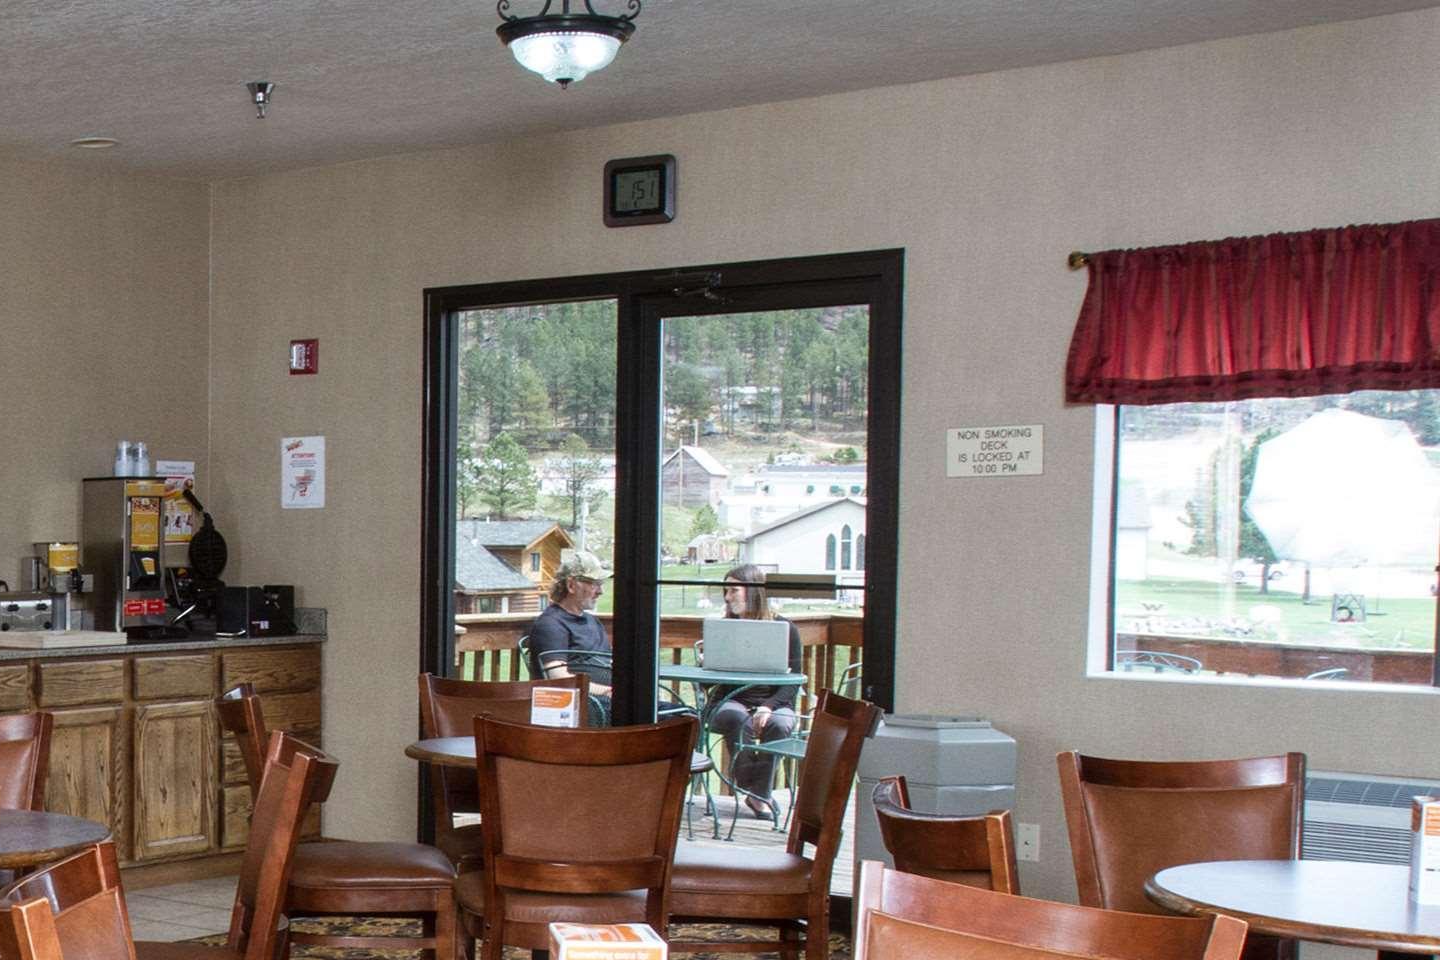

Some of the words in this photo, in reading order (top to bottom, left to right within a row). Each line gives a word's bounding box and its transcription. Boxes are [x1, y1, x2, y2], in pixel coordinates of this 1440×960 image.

[958, 430, 980, 440] NON
[984, 427, 1032, 439] SMOKING
[980, 441, 1008, 451] DECK
[958, 453, 968, 463] IS
[972, 452, 1013, 462] LOCKED
[1017, 451, 1031, 460] AT
[1001, 463, 1017, 473] PM
